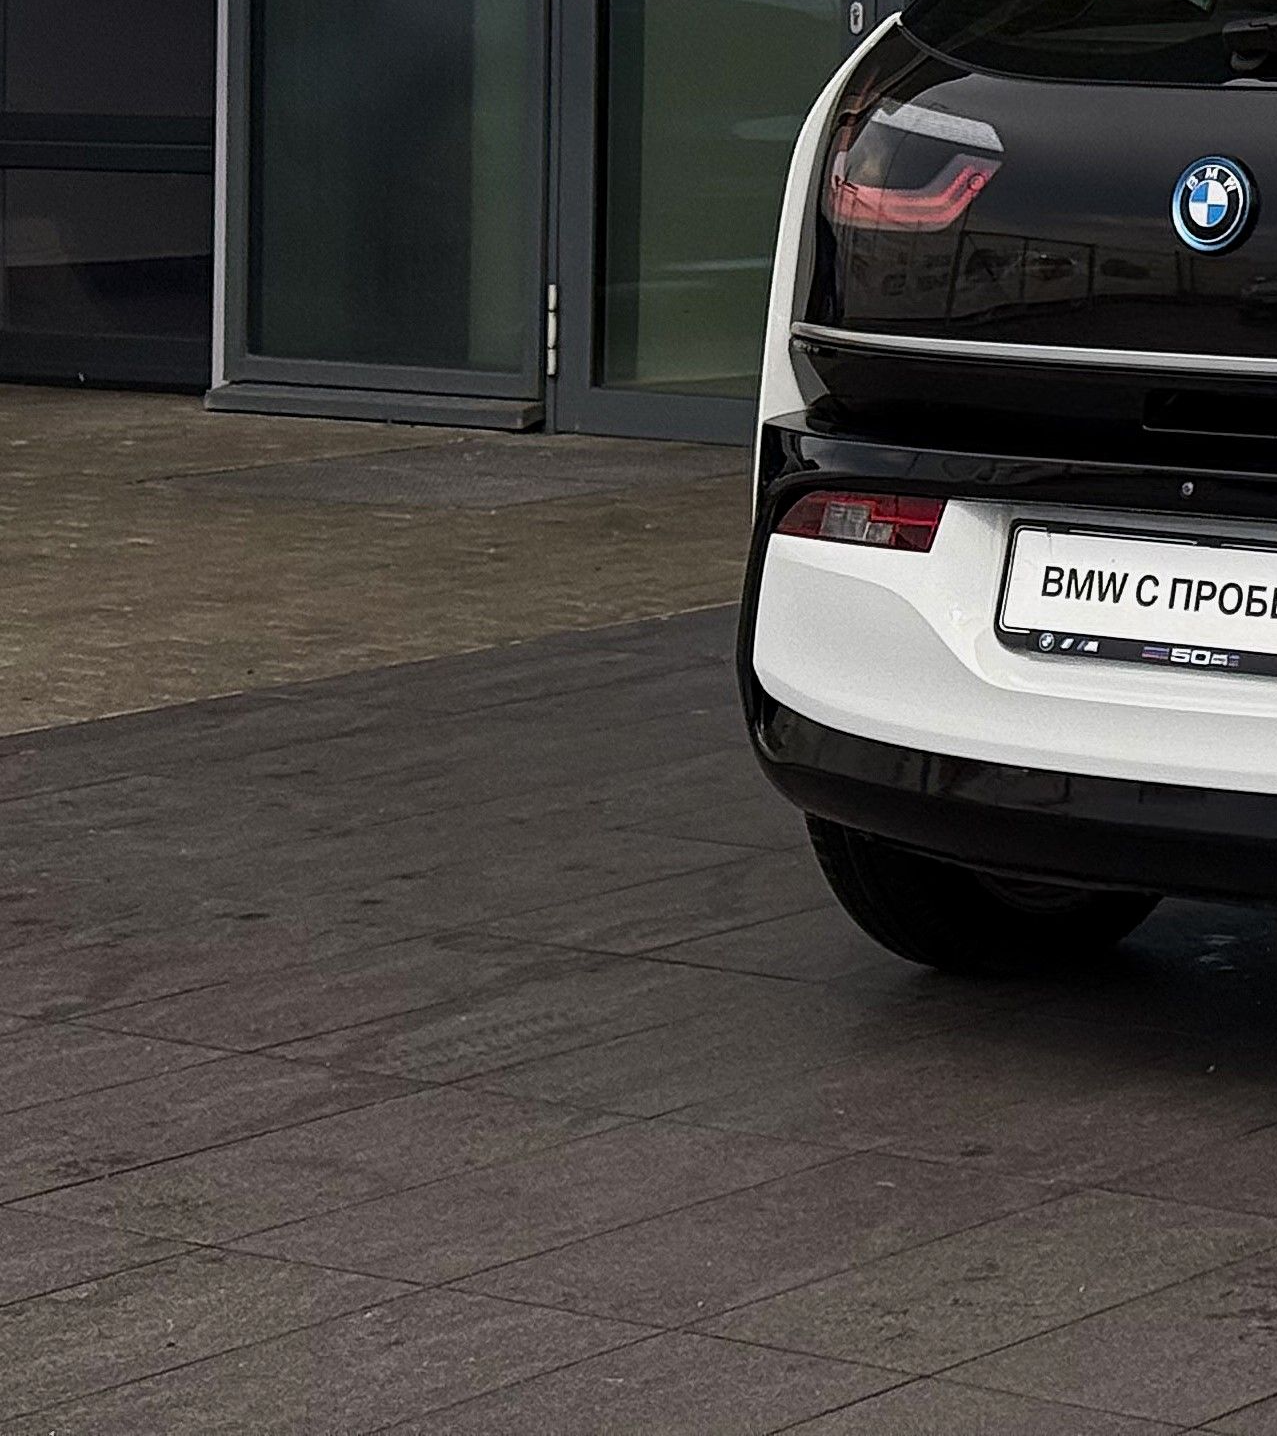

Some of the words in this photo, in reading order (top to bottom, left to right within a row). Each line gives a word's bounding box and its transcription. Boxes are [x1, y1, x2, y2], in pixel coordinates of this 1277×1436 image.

[1185, 166, 1238, 193] BMW
[1041, 565, 1129, 605] BMW
[1135, 574, 1159, 607] С
